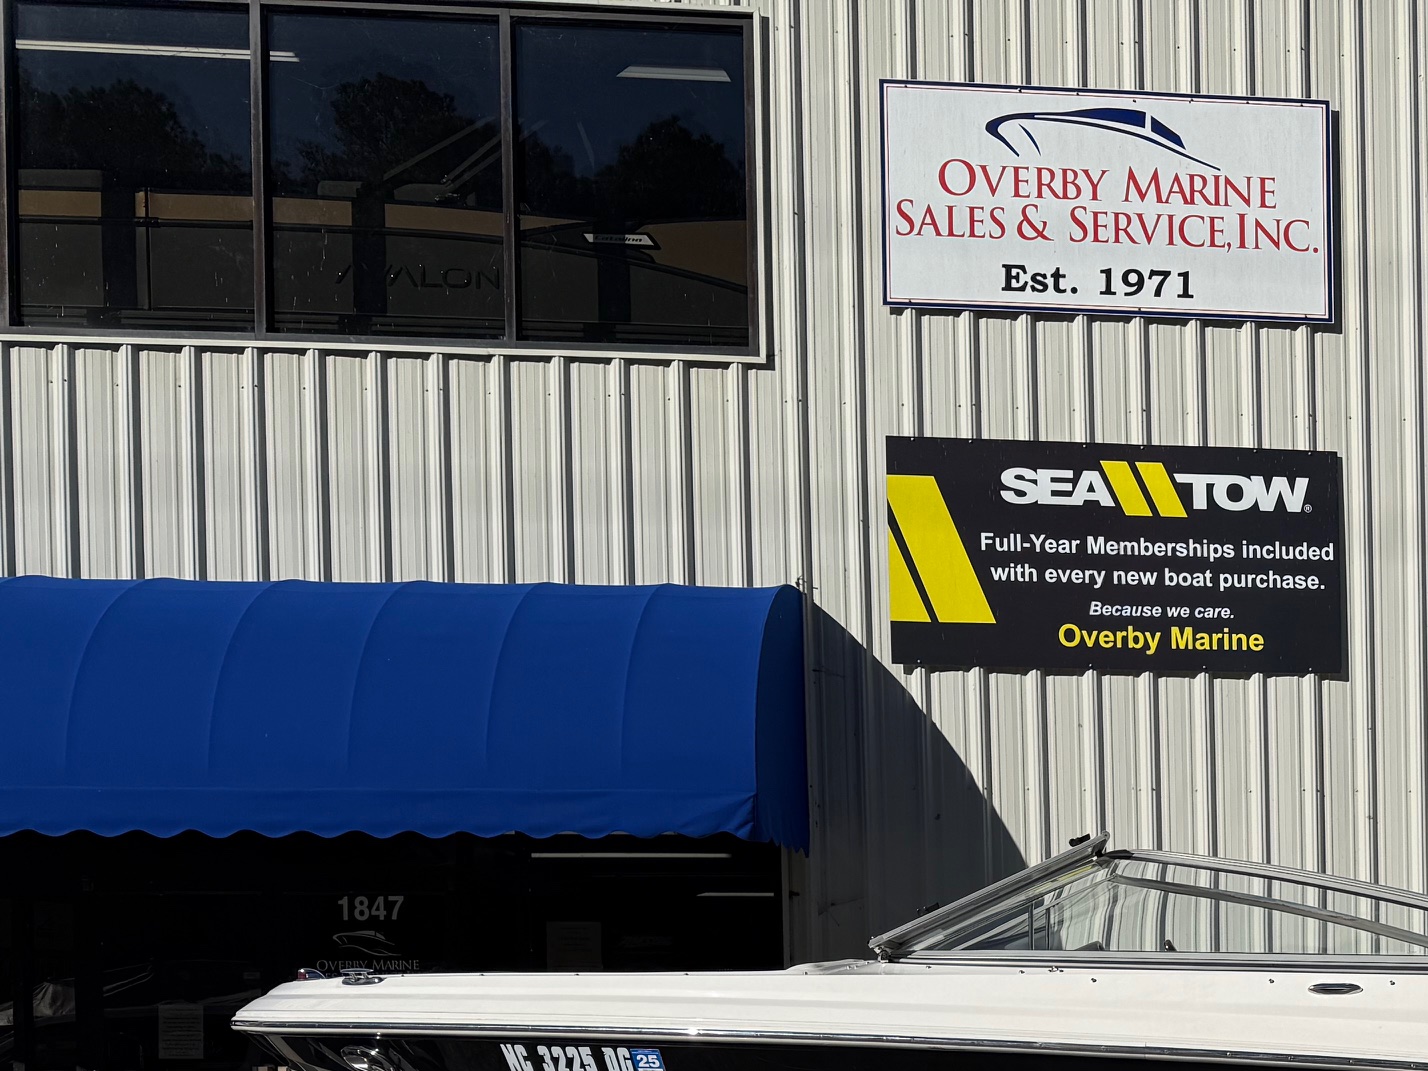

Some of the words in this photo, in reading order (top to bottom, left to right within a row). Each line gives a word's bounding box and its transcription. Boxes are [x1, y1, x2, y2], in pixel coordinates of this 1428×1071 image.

[938, 158, 1110, 202] OVERBY
[1121, 165, 1277, 210] MARINE
[895, 198, 1006, 240] SALES
[1016, 203, 1054, 242] &
[1001, 263, 1079, 294] Est.
[1098, 267, 1195, 300] 1971
[999, 466, 1115, 508] SEA
[979, 531, 1081, 556] Full-Year
[1086, 534, 1236, 562] Memberships
[1241, 539, 1335, 562] included
[990, 562, 1039, 583] with
[1044, 567, 1106, 589] every
[1112, 569, 1158, 587] new
[1164, 566, 1213, 588] boat
[1218, 568, 1327, 594] purchase.
[1088, 600, 1163, 618] Because
[1166, 606, 1192, 619] we
[1194, 606, 1235, 620] care.
[1057, 622, 1161, 655] Overby
[1170, 626, 1266, 653] Marine
[337, 895, 404, 921] 1847
[316, 959, 368, 971] OVERBY
[372, 959, 420, 971] MARINE
[636, 1054, 660, 1068] 25
